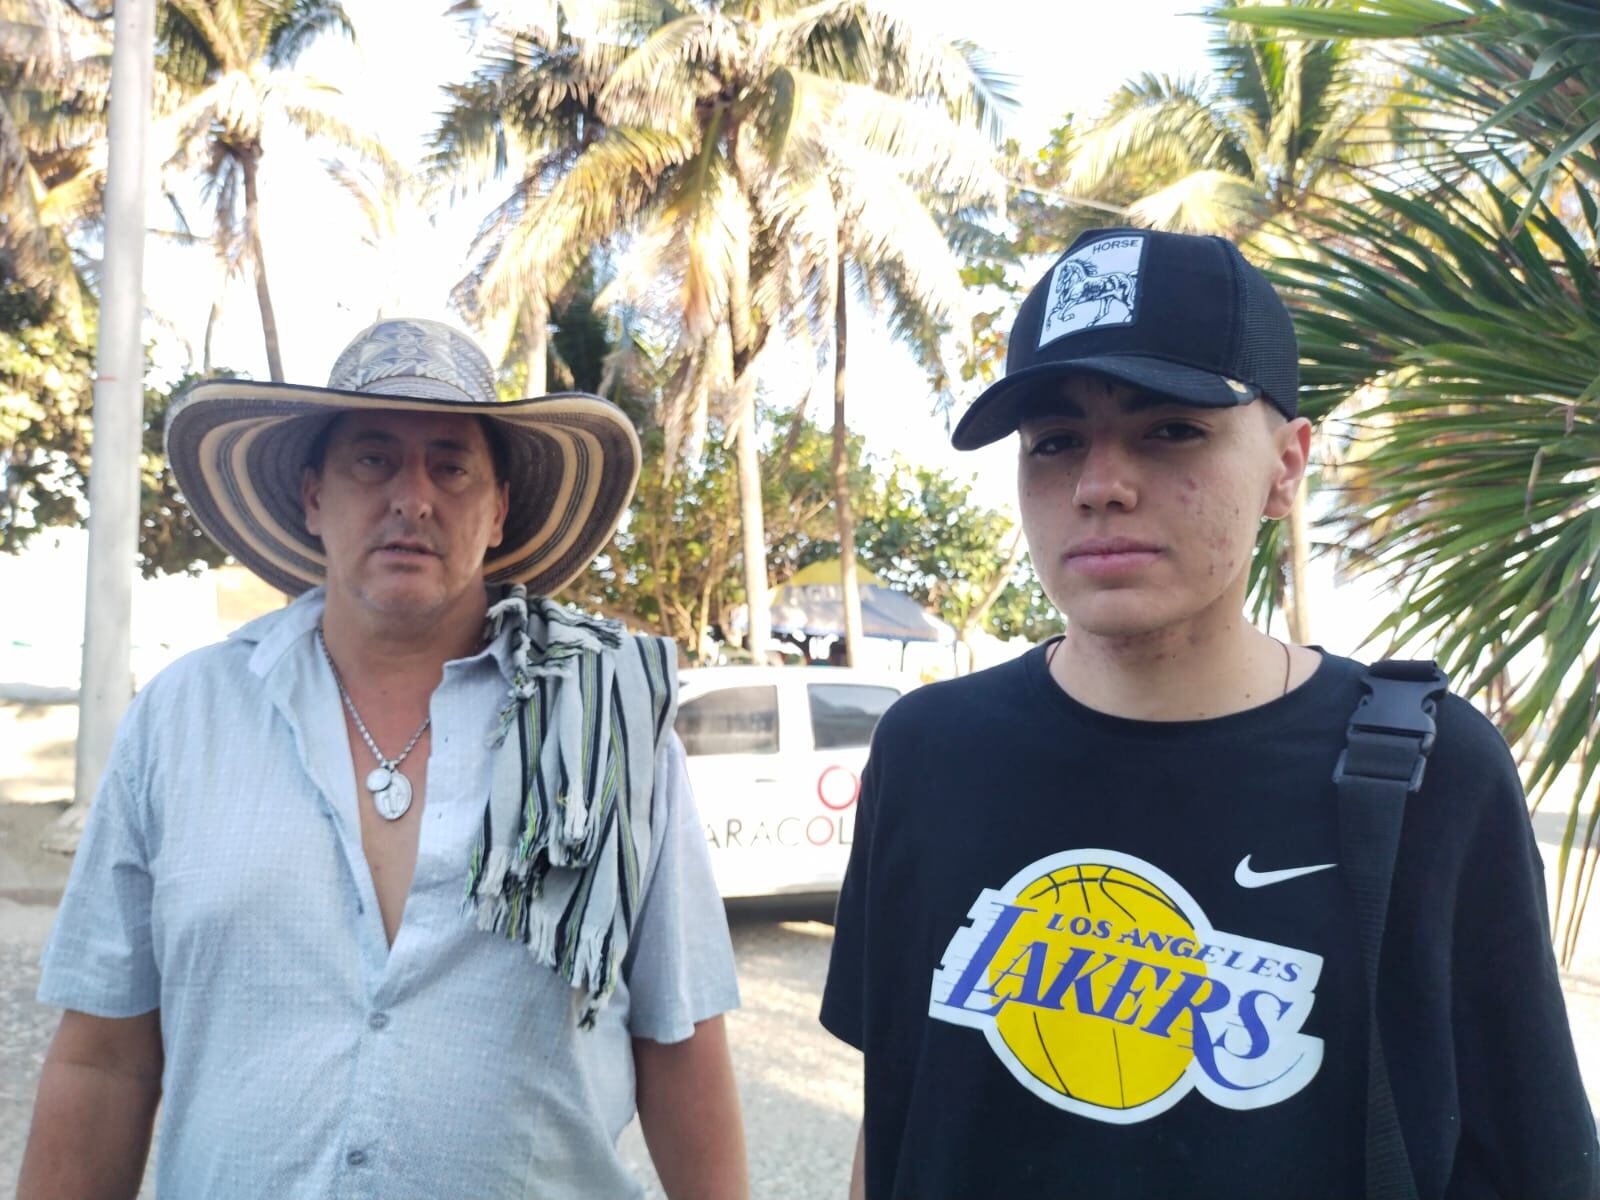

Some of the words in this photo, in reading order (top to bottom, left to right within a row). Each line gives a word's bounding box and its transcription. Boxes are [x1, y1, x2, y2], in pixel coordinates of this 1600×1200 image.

[1092, 239, 1139, 254] HORSE
[1046, 913, 1113, 939] LOS
[1117, 928, 1302, 982] ANGELES
[934, 902, 1304, 1090] LAKERS
